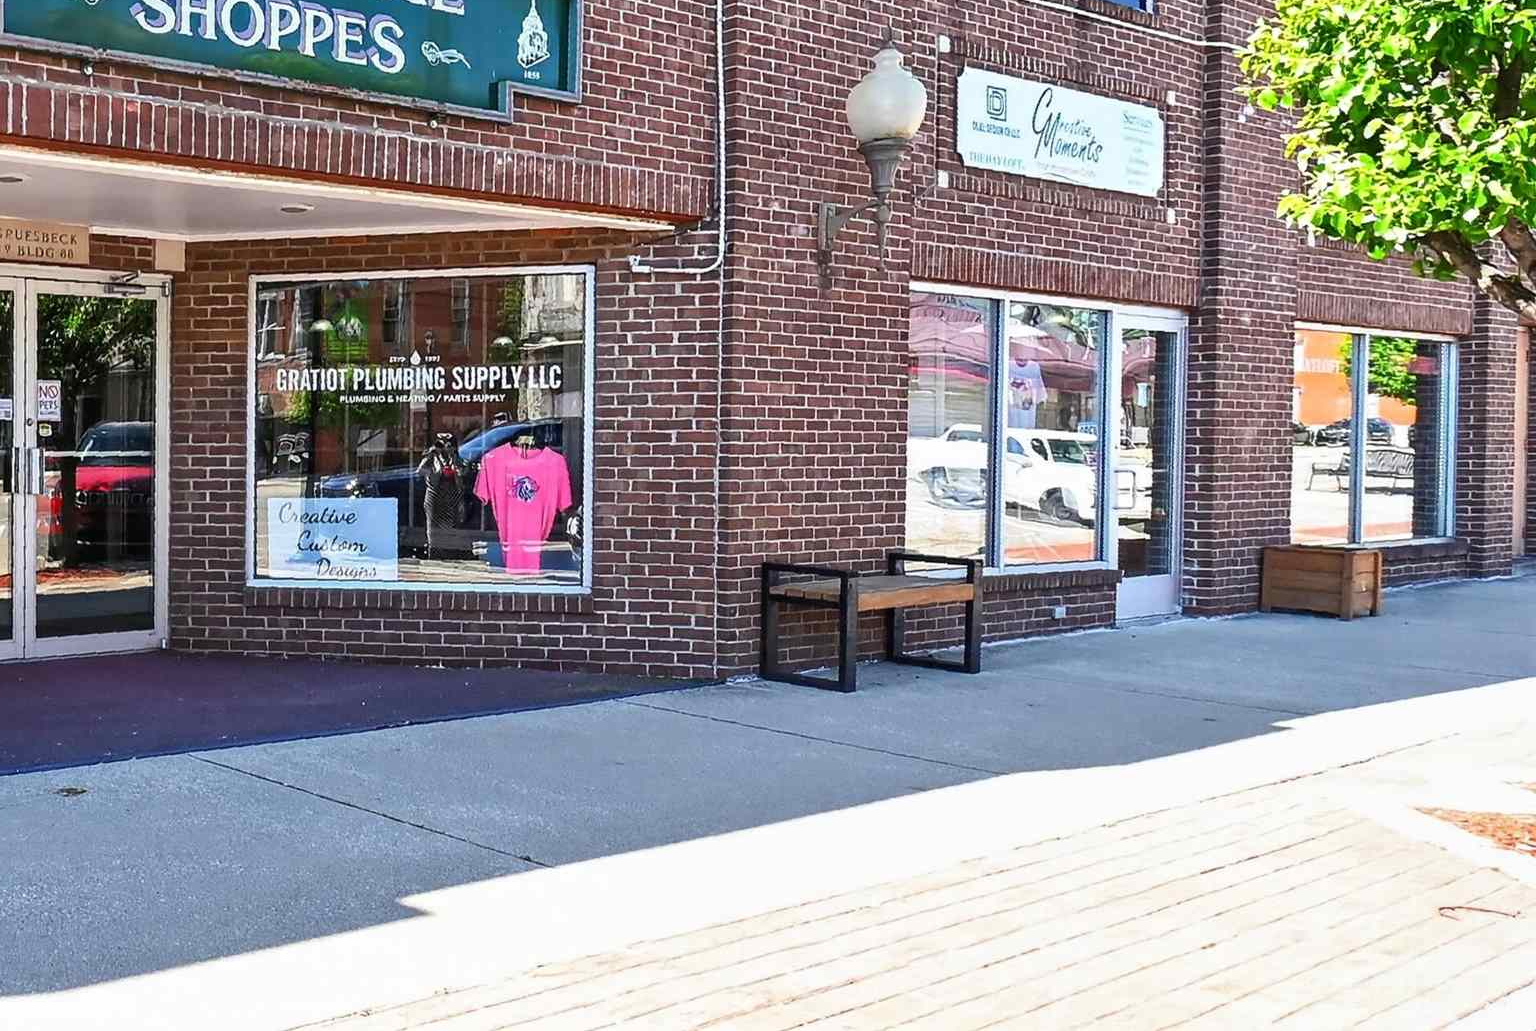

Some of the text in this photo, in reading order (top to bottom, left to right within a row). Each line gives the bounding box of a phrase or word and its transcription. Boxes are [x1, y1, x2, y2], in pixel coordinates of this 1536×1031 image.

[18, 245, 55, 258] BLDG
[276, 365, 562, 391] GRATIOT PLUMBING SUPPLY LLC
[340, 395, 385, 403] PLUMBING
[395, 394, 435, 403] HEATING
[443, 394, 471, 403] PARTS
[472, 394, 506, 403] SUPPLY
[279, 502, 358, 524] Creative
[297, 530, 368, 552] Custom
[316, 557, 377, 578] Designs
